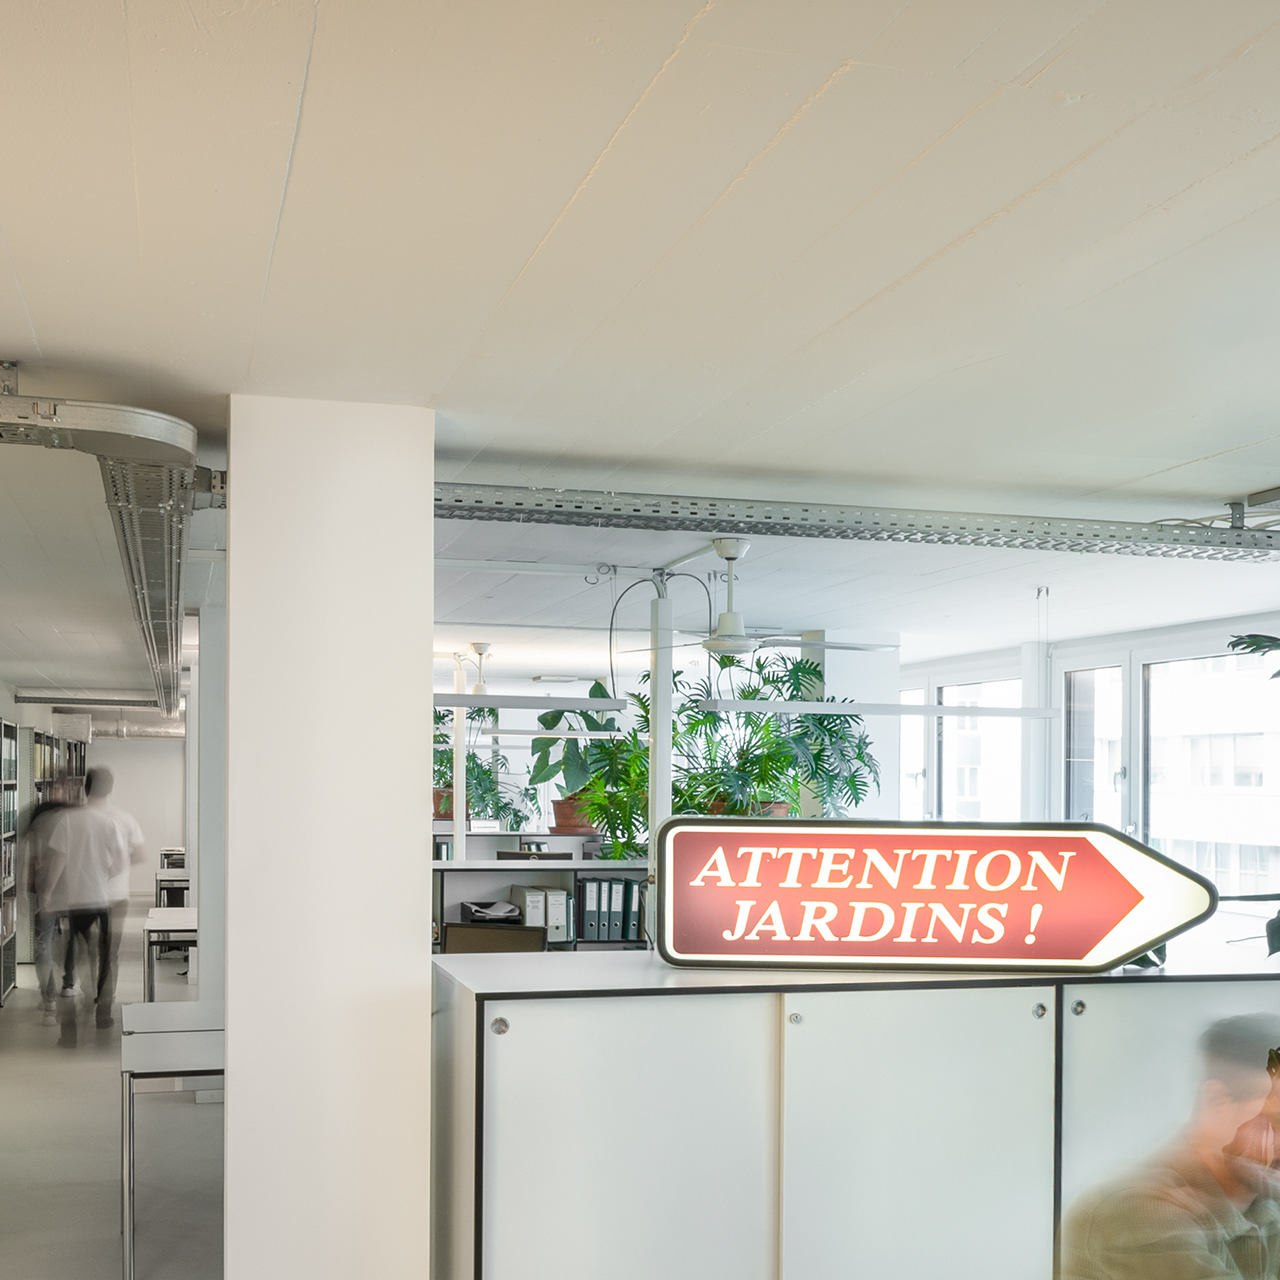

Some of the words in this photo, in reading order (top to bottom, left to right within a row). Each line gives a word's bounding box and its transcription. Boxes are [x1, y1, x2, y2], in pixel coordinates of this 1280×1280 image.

[689, 845, 1076, 892] ATTENTION
[722, 900, 1009, 945] JARDINS
[1024, 904, 1044, 945] !
